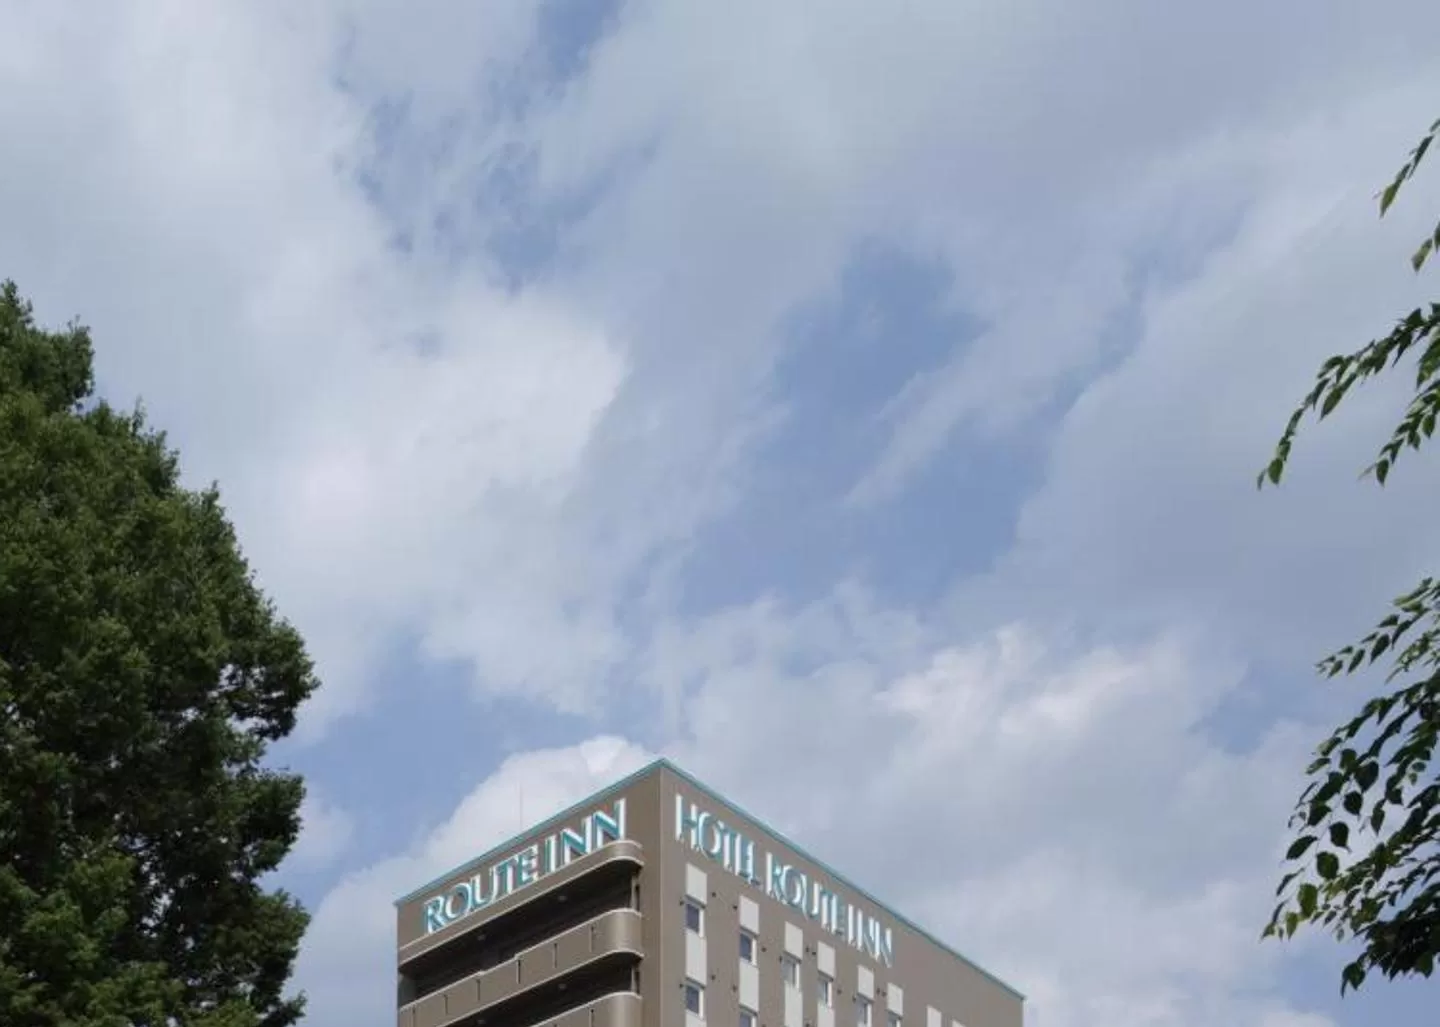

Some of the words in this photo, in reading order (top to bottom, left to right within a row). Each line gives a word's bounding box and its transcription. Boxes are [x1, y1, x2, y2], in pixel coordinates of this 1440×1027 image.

[423, 844, 539, 934] ROUTE
[545, 798, 626, 874] INN
[675, 793, 763, 888] HOTEL
[766, 852, 847, 940] ROUTE
[848, 904, 893, 968] INN
